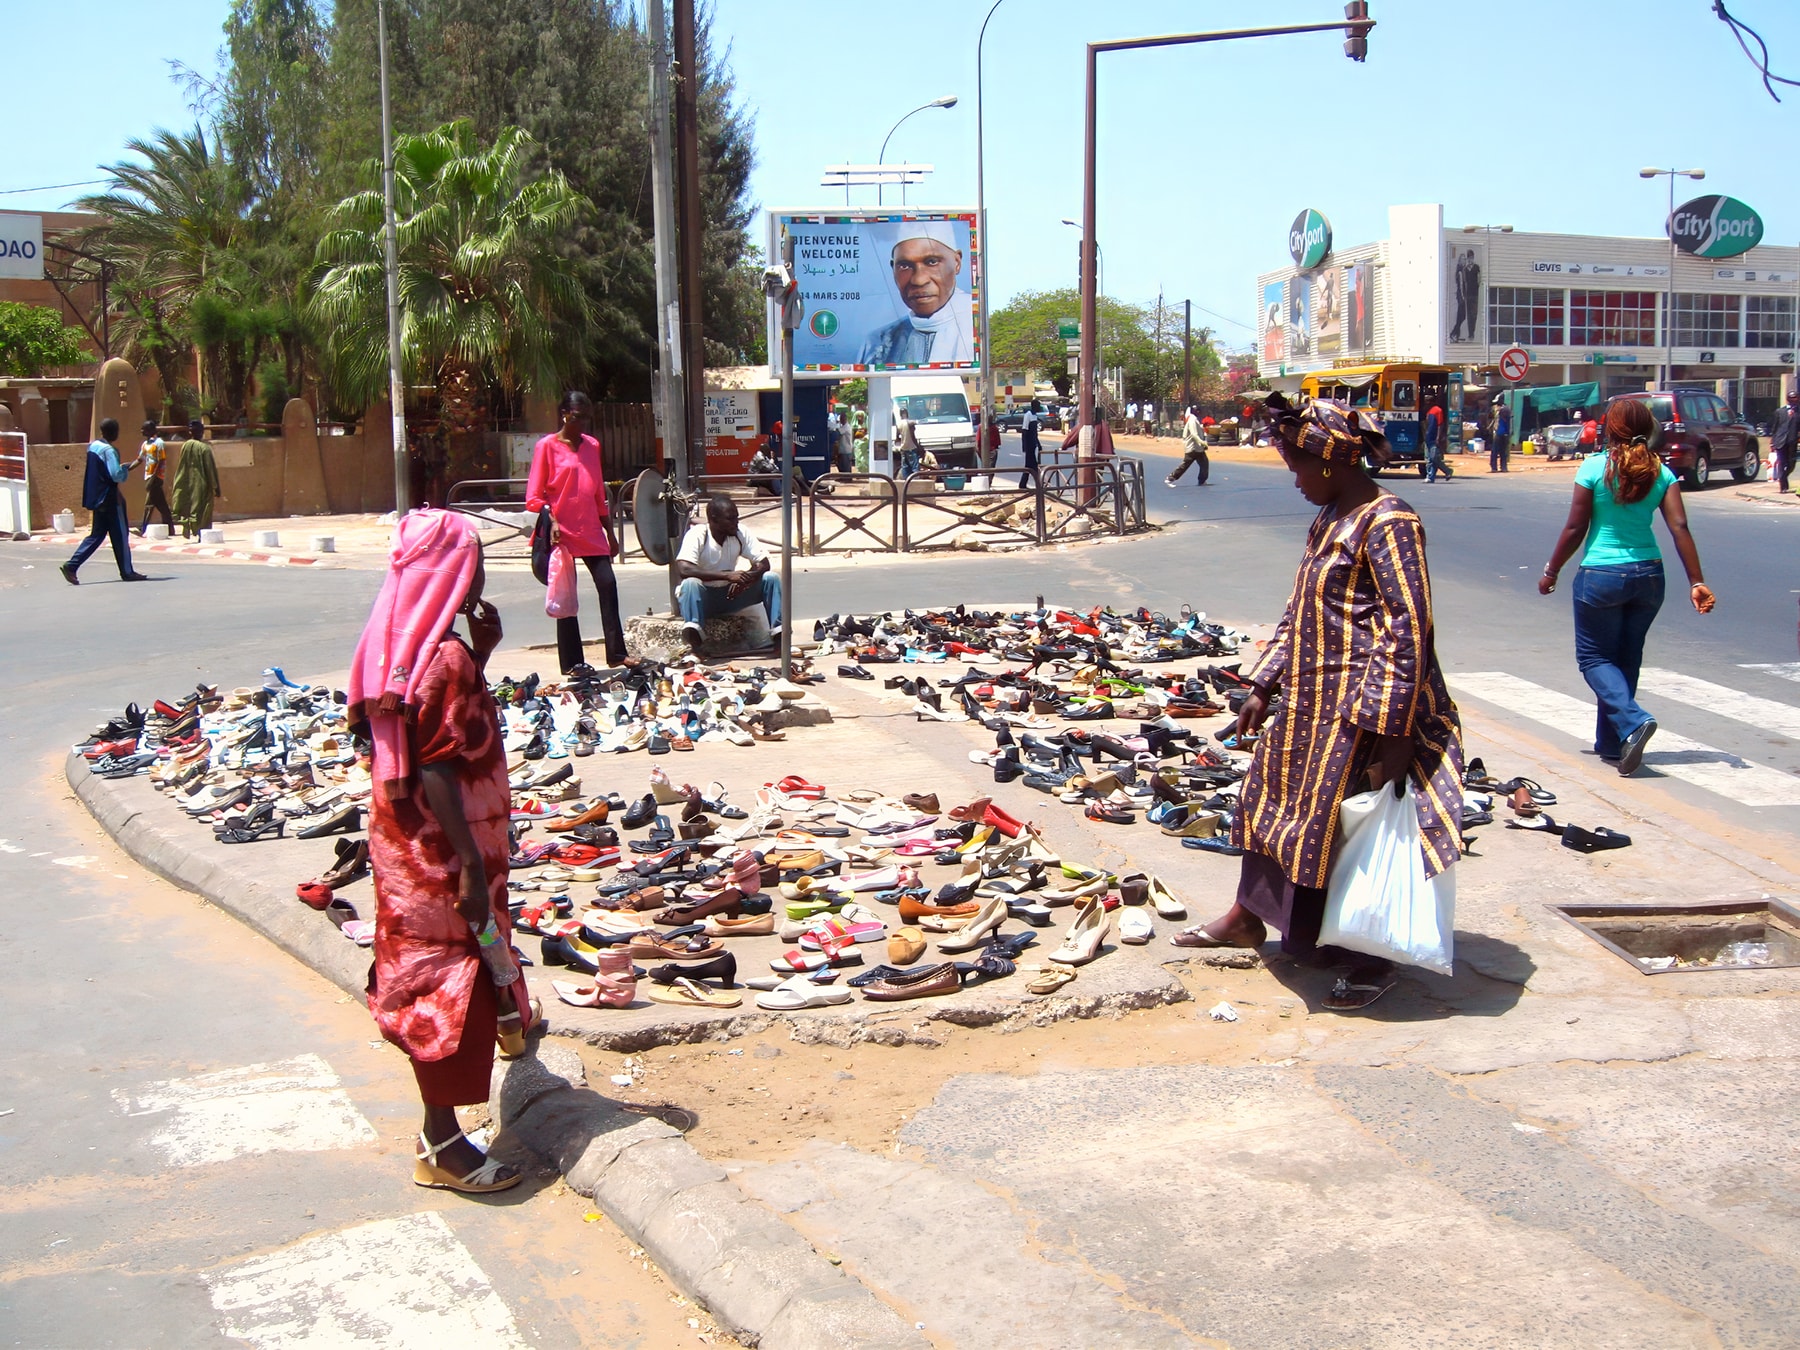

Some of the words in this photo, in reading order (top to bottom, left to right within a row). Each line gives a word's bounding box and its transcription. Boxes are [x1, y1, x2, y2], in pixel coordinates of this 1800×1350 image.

[801, 249, 860, 259] WELCOME
[813, 292, 838, 300] MARS
[840, 292, 861, 300] 2008
